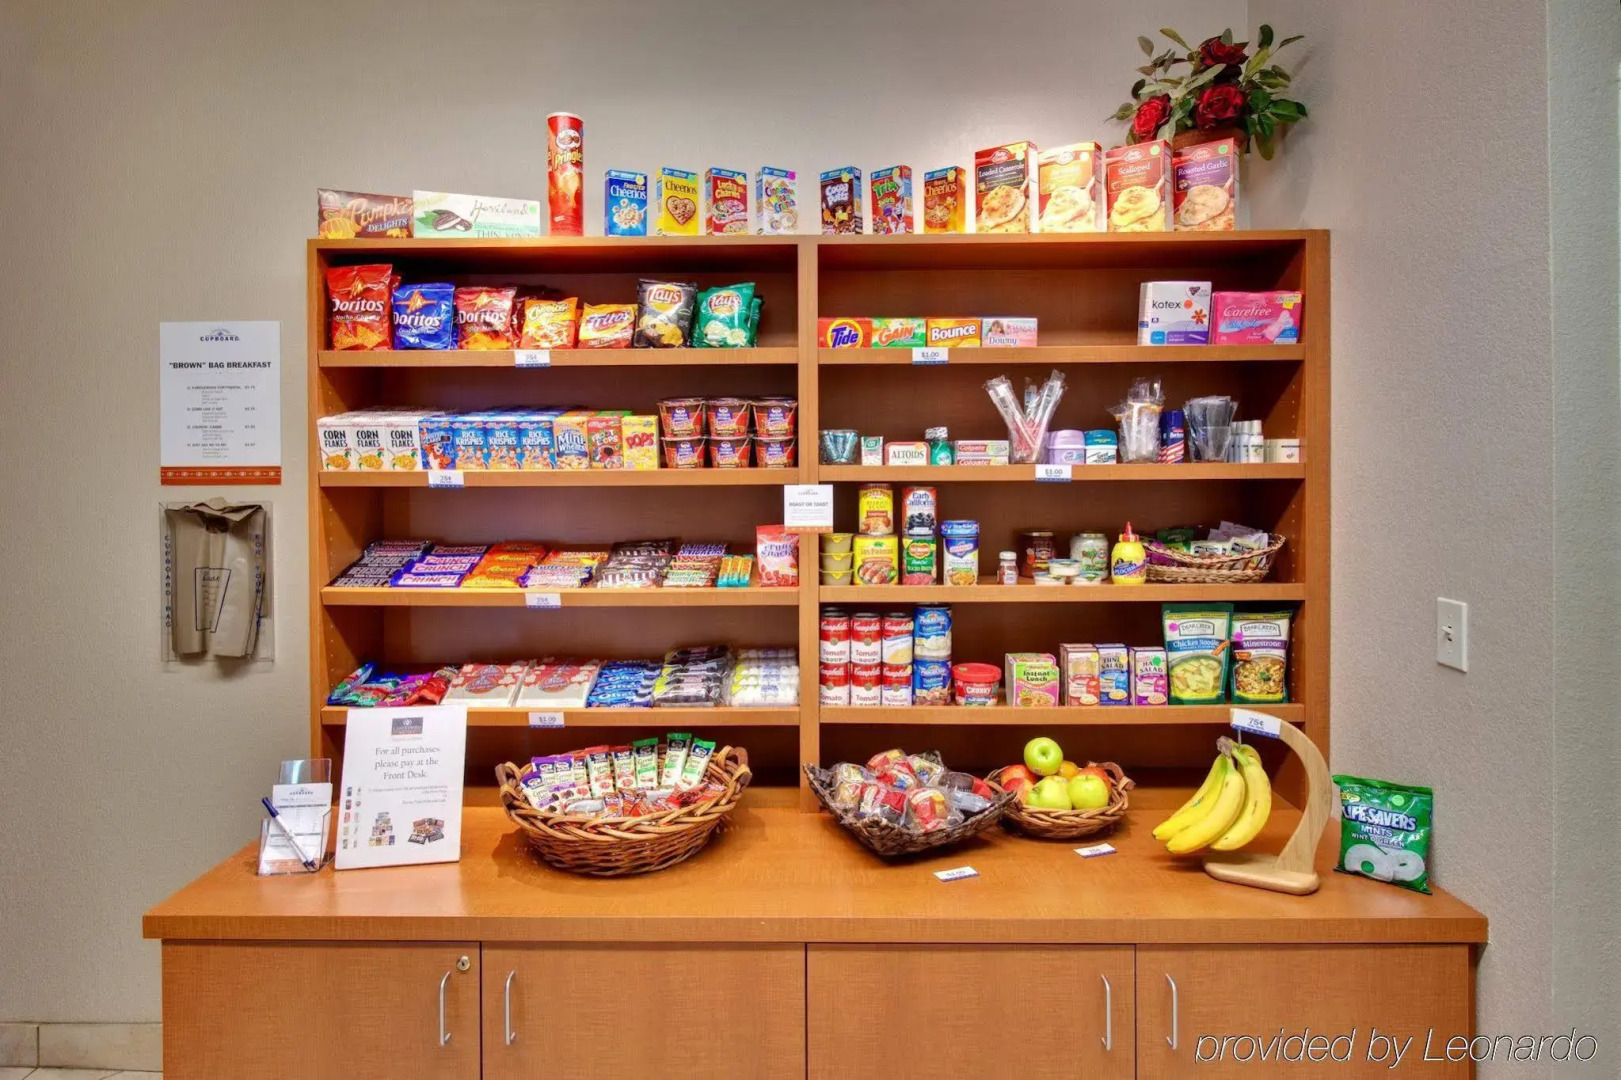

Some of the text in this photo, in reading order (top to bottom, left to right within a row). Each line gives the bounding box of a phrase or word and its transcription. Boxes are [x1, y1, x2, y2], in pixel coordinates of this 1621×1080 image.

[1151, 299, 1182, 310] kotex
[1223, 304, 1272, 317] Carefree
[831, 326, 859, 348] Tide
[931, 324, 977, 341] Bounce
[323, 430, 346, 439] CORN
[356, 430, 379, 439] CORN
[390, 430, 413, 439] CORN
[325, 439, 348, 448] FLAKES
[357, 439, 380, 448] FLAKES
[391, 439, 415, 448] FLAKES
[891, 450, 925, 459] ALTOIDS
[912, 492, 930, 500] Early
[1173, 640, 1199, 648] Chicken
[375, 746, 440, 758] For all purchases
[375, 757, 439, 770] please pay at the
[383, 770, 427, 780] Front Desk
[1361, 825, 1393, 837] MINTS
